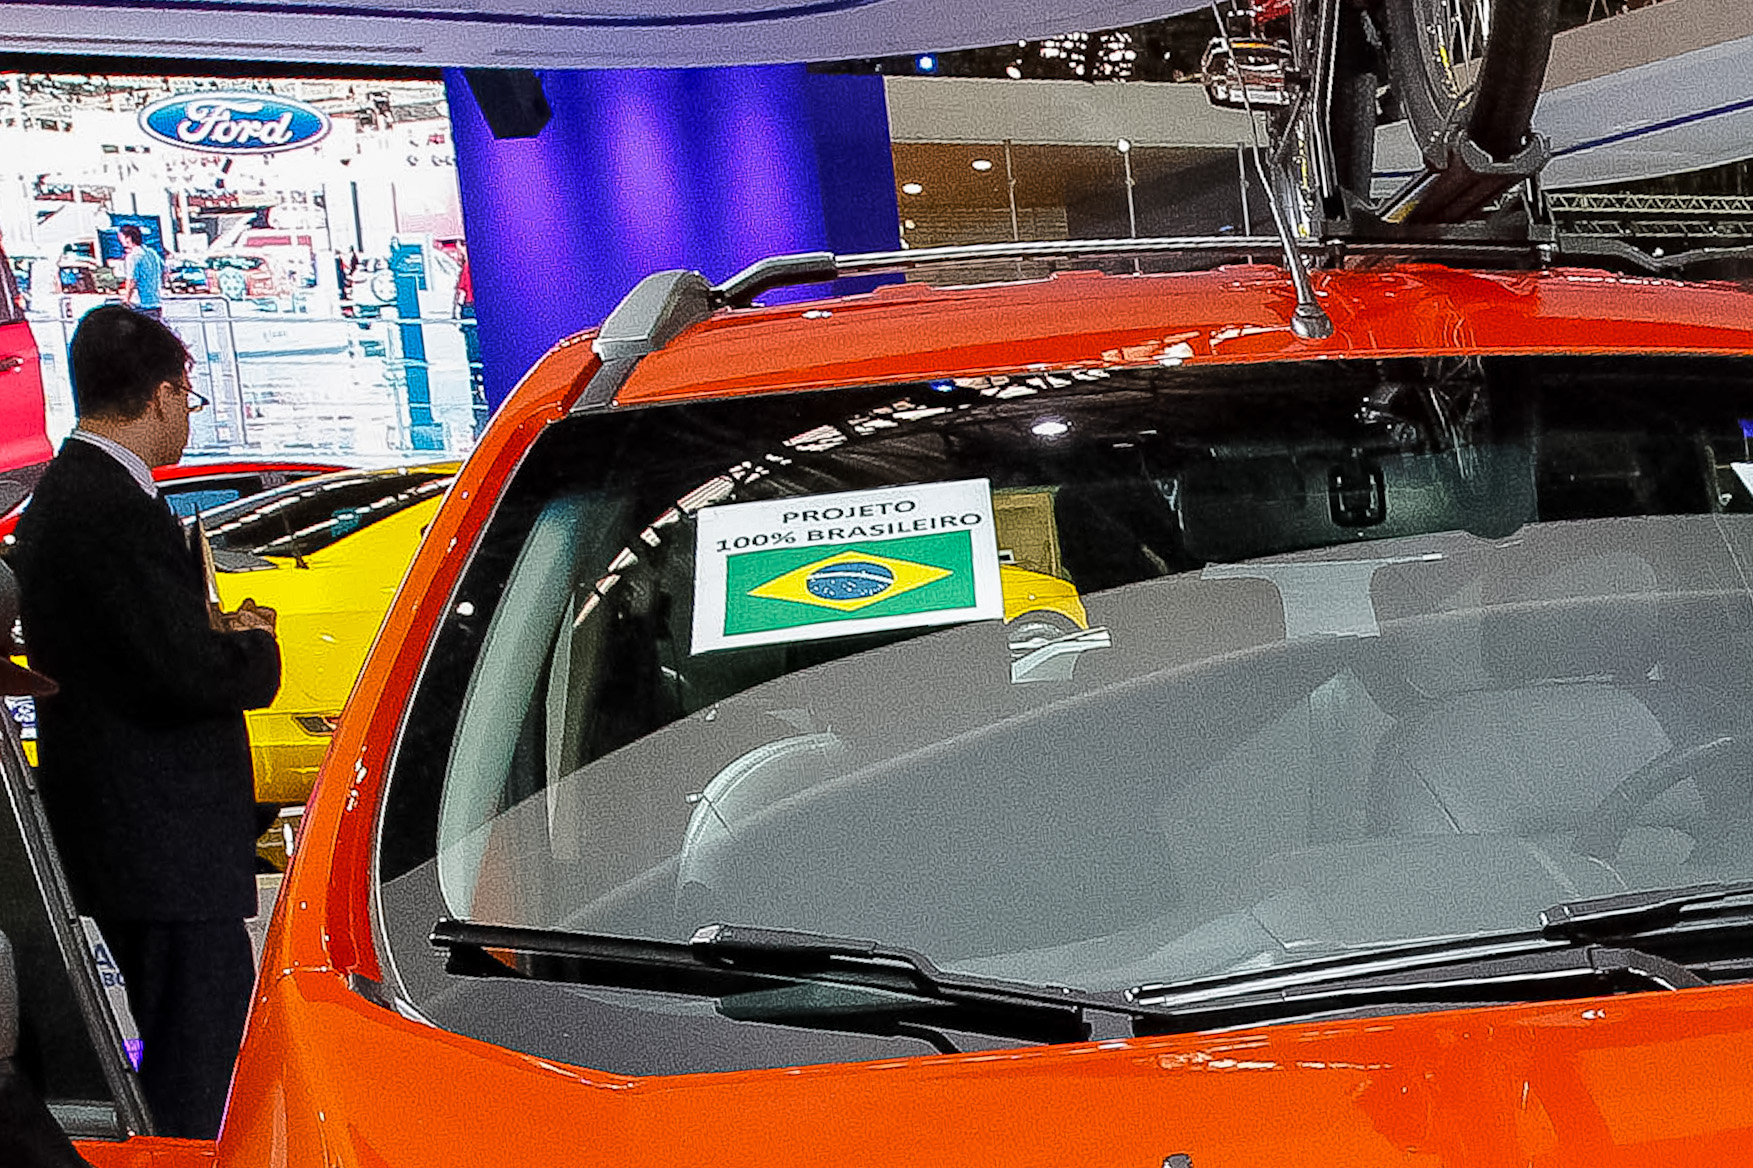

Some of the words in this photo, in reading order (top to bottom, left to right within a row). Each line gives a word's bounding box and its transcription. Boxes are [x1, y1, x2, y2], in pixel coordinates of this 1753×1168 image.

[176, 101, 294, 145] Ford
[782, 500, 917, 524] PROJETO
[716, 531, 797, 553] 100%
[807, 513, 983, 543] BRASILEIRO
